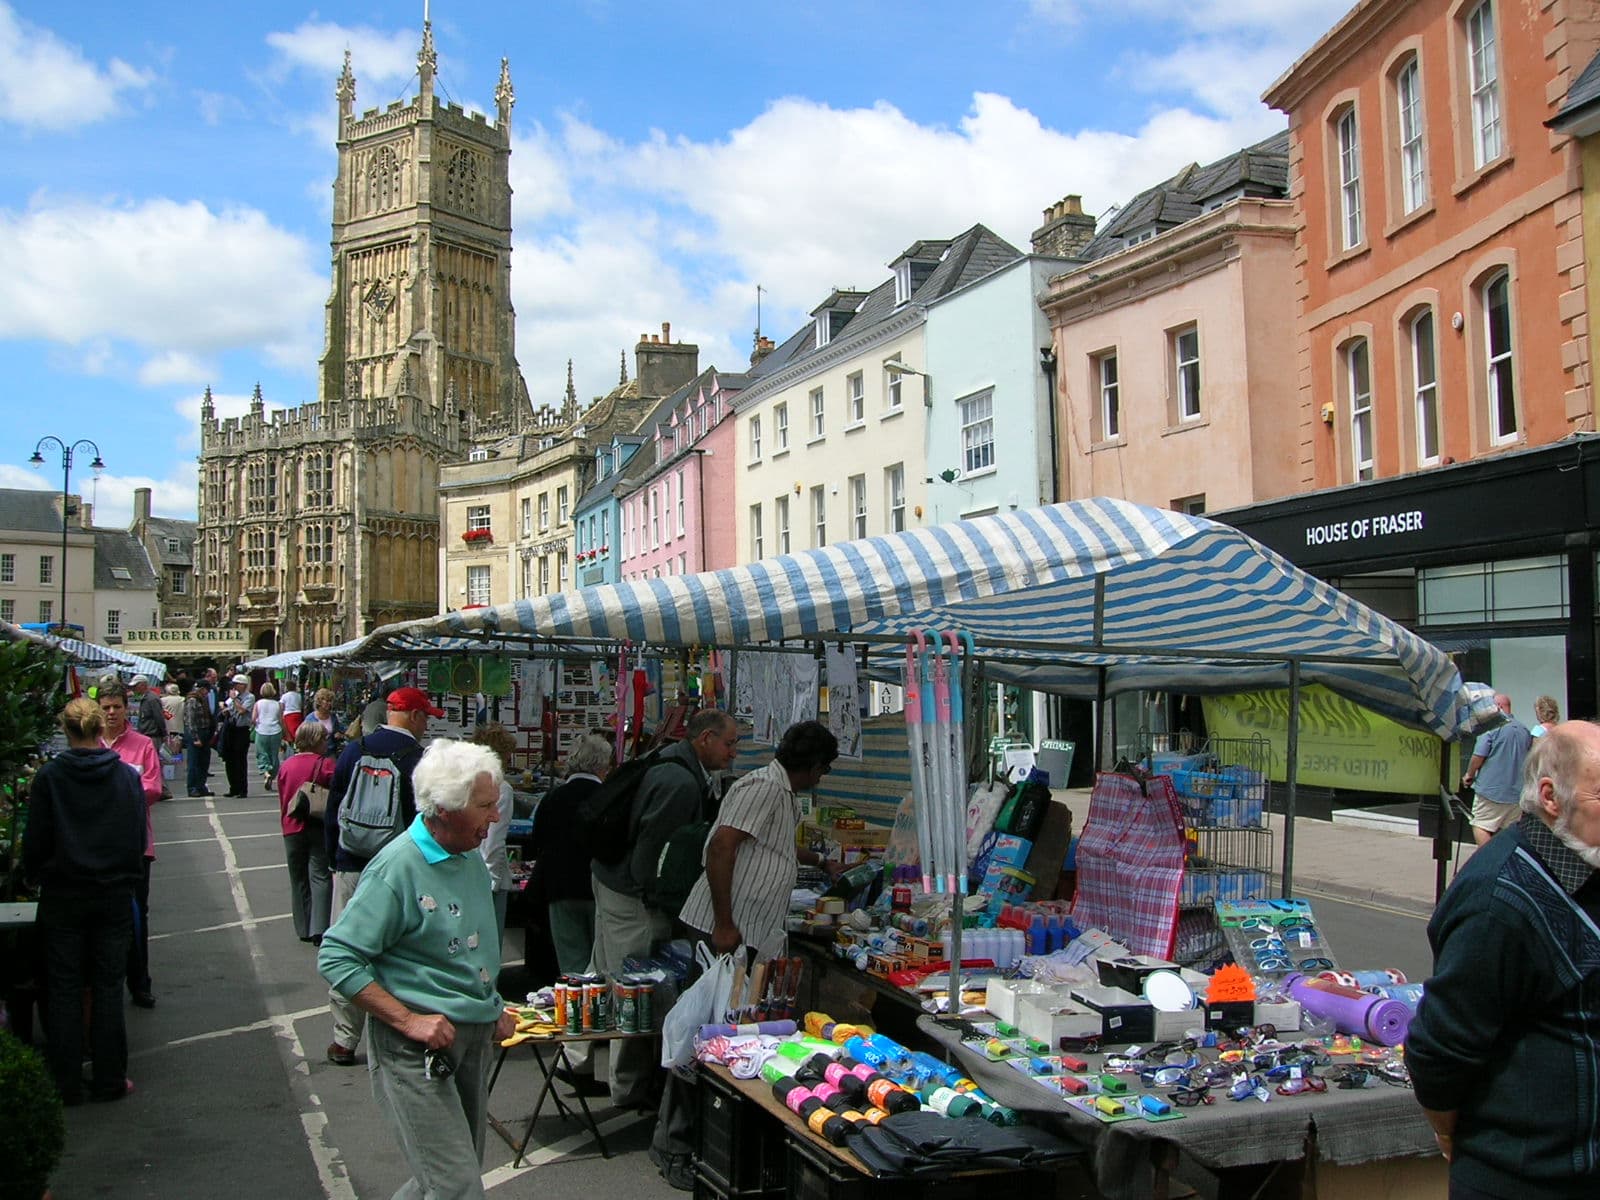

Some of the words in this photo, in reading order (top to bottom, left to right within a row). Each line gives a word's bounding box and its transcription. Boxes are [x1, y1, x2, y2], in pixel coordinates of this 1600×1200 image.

[1306, 522, 1349, 545] HOUSE
[1351, 519, 1369, 539] OF
[1372, 510, 1423, 536] FRASER
[127, 631, 192, 641] BURGER
[196, 631, 243, 641] GRILL
[881, 686, 891, 714] AUR
